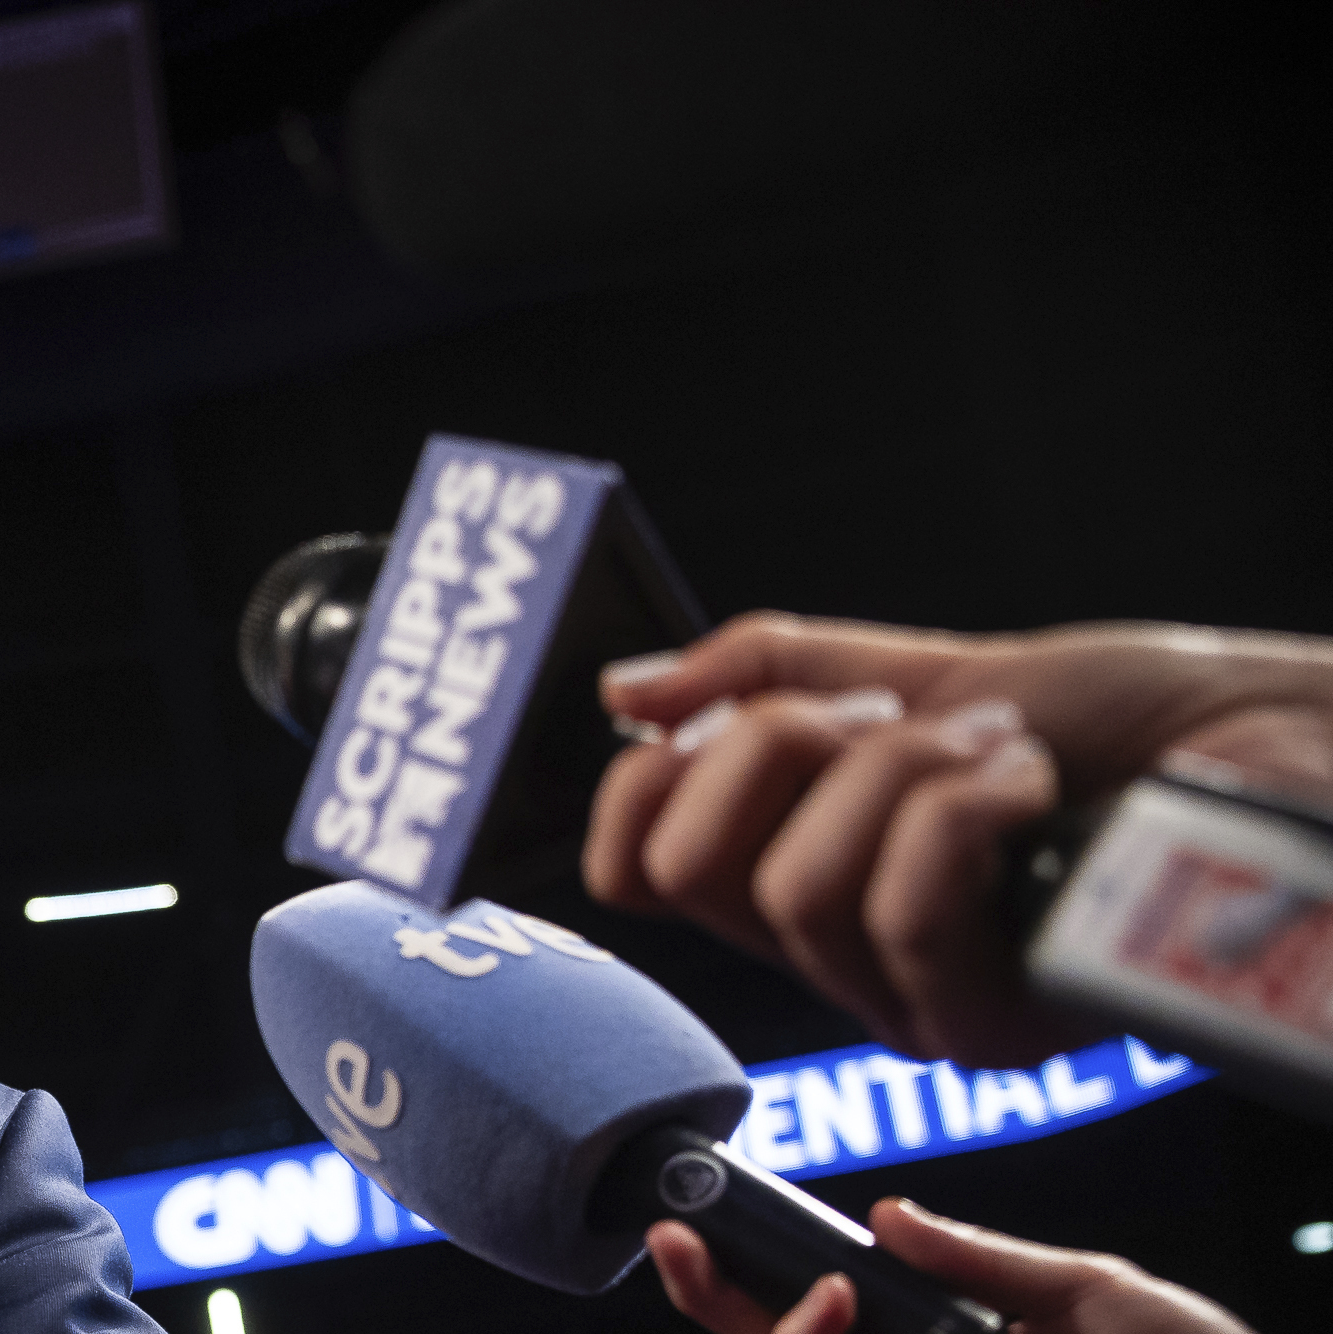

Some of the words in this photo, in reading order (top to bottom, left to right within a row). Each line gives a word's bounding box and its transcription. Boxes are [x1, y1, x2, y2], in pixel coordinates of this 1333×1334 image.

[312, 460, 499, 857] SCRIPPS
[408, 472, 567, 767] NEWS
[393, 914, 613, 978] tve
[727, 1052, 1116, 1173] ENTIAL
[153, 1152, 359, 1270] CNN
